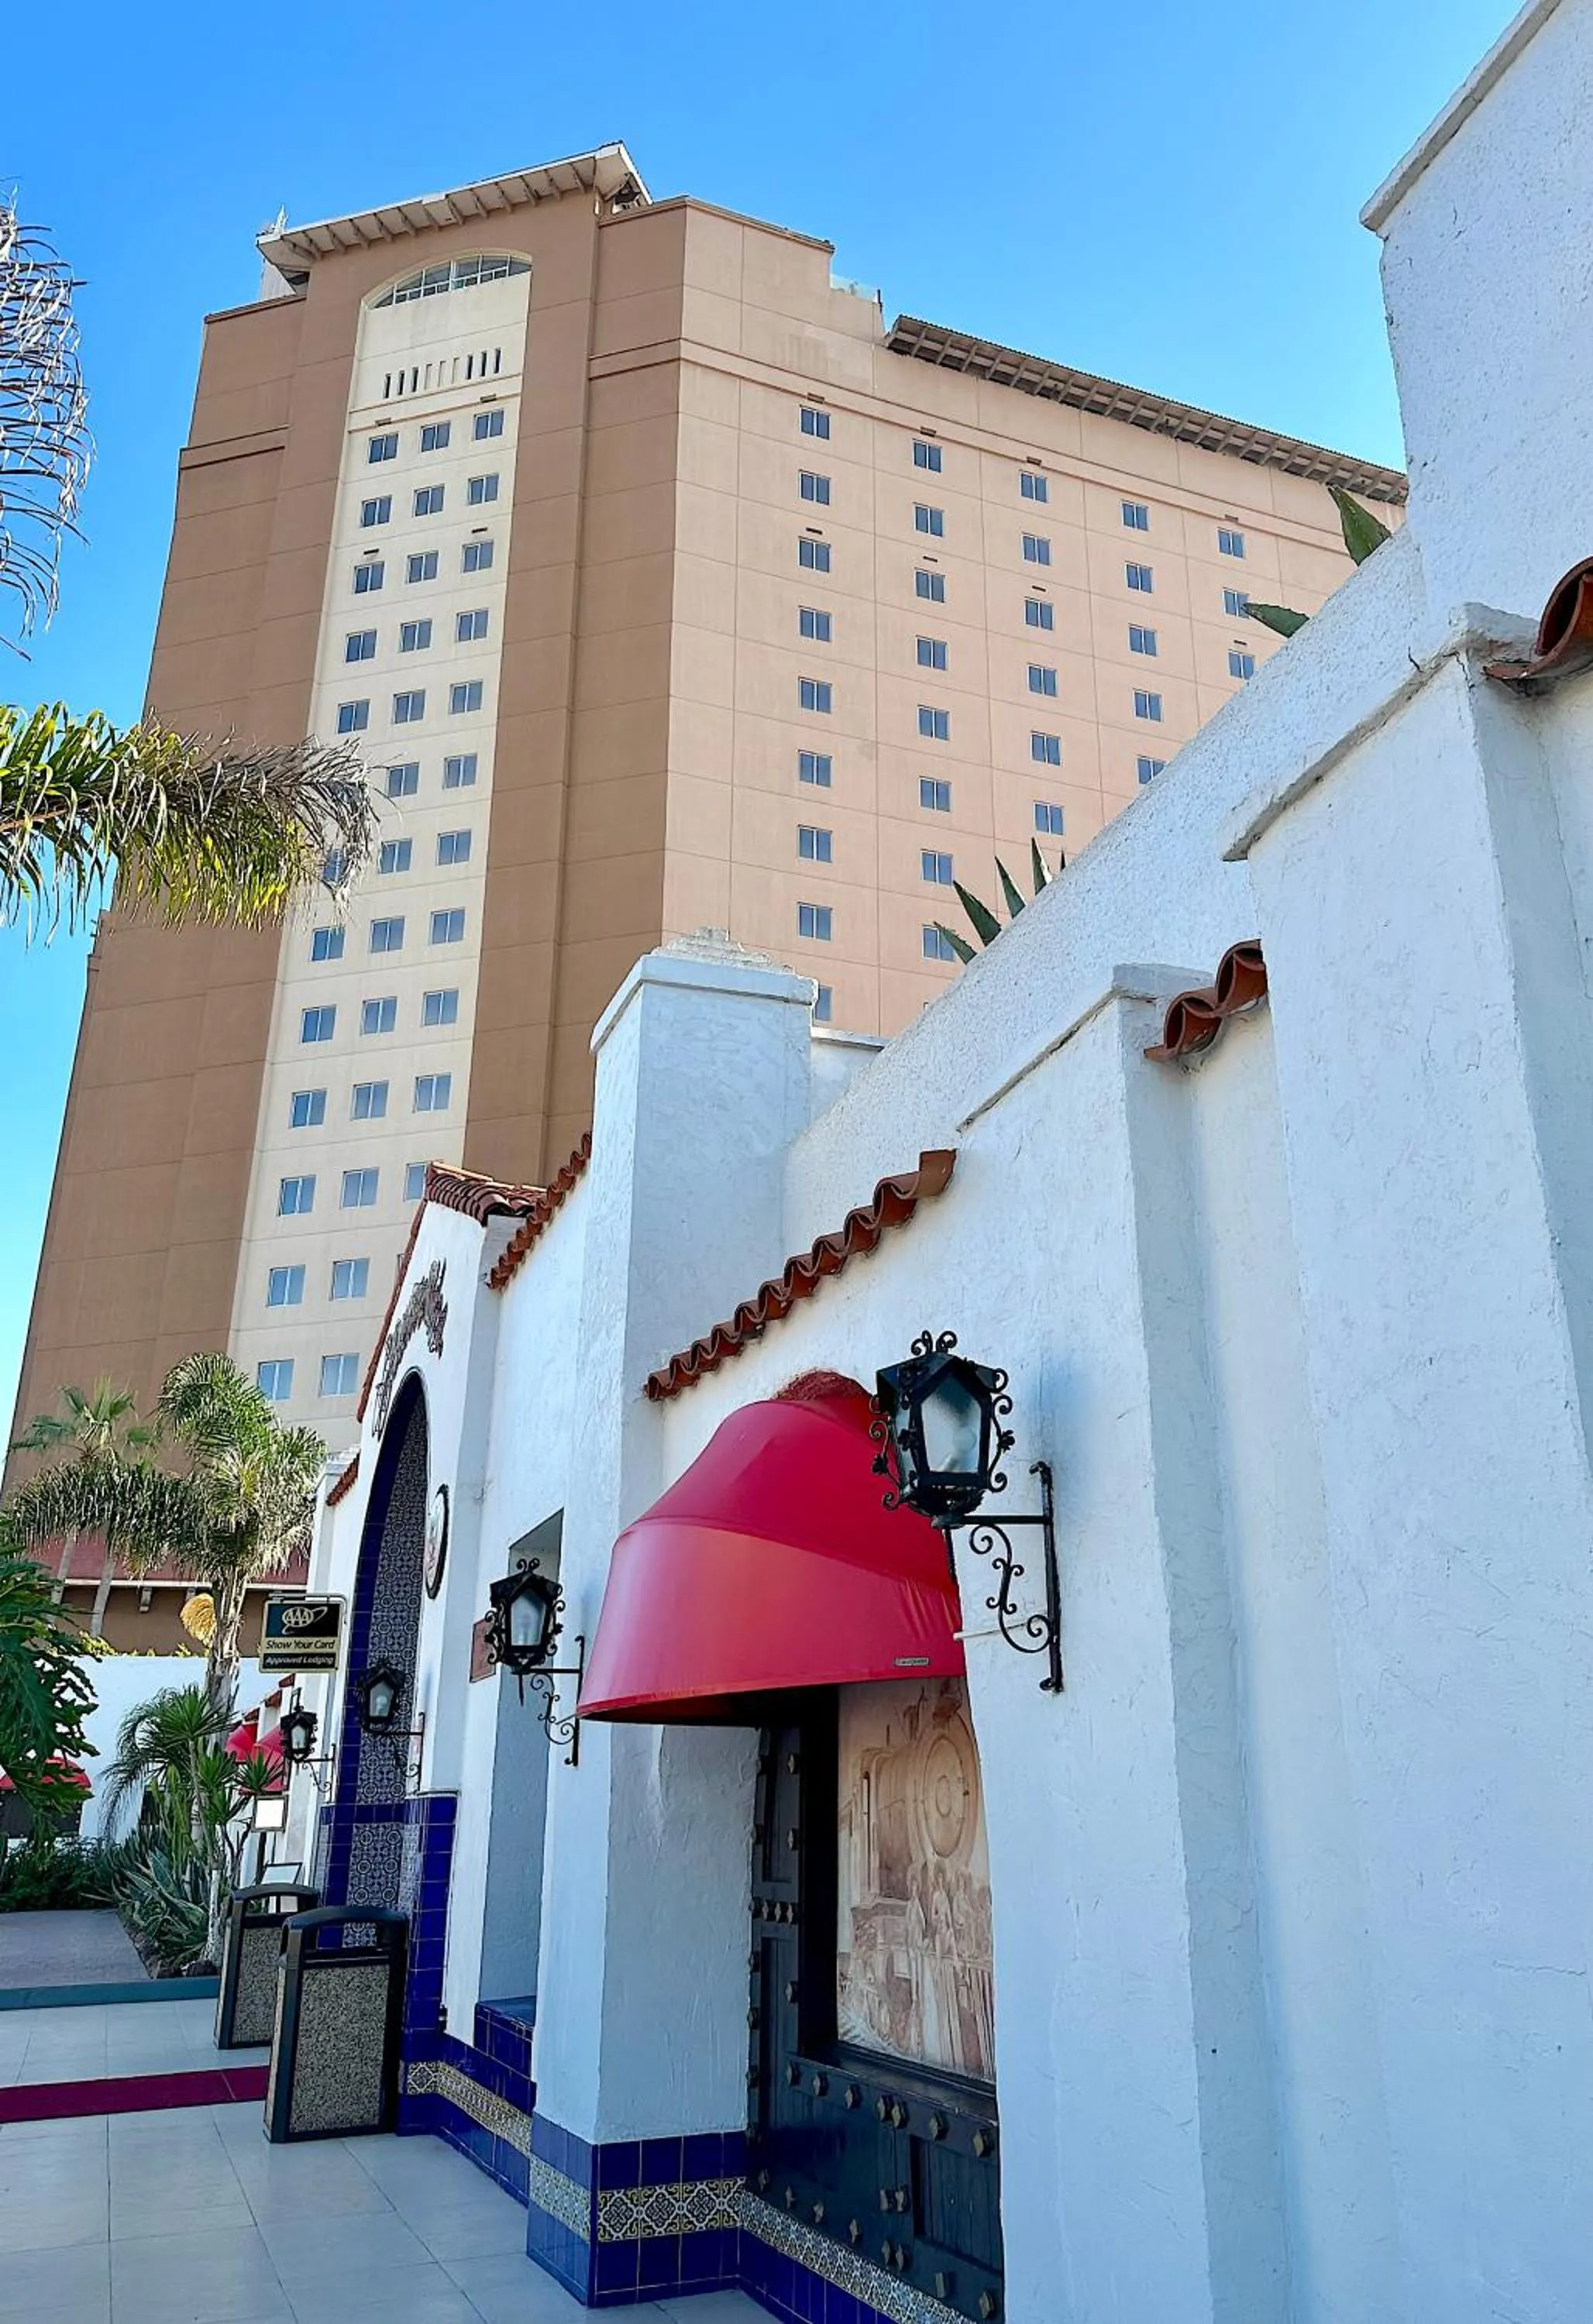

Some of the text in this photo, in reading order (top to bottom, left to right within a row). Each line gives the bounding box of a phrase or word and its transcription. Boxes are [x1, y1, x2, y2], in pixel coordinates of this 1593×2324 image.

[284, 1606, 311, 1627] AAA
[266, 1638, 335, 1650] Show Your Card
[266, 1655, 333, 1666] Approved Lodging
